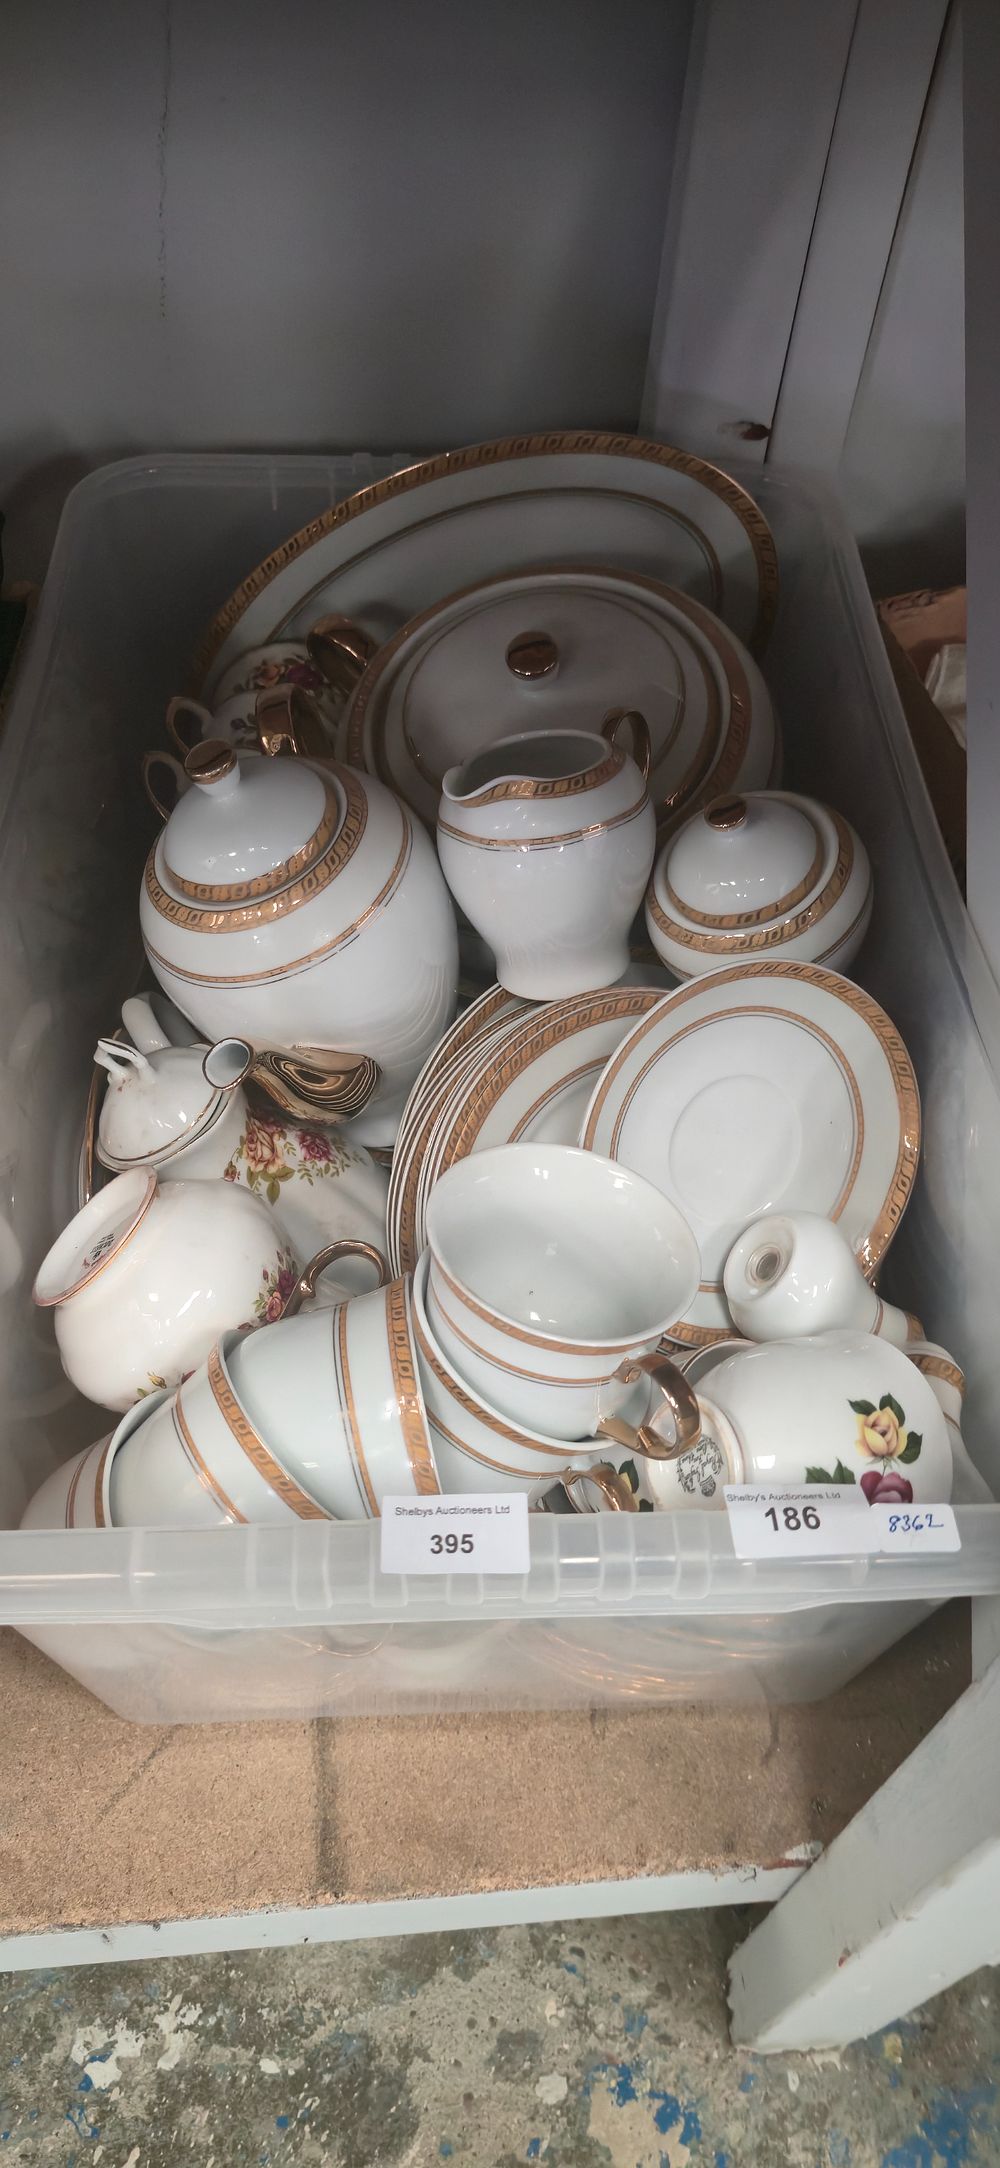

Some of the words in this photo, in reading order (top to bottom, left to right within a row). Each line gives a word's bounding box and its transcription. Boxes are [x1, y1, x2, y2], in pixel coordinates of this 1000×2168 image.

[726, 1493, 766, 1503] Shelby's
[768, 1492, 823, 1501] Auctioneers
[826, 1492, 841, 1500] Ltd
[395, 1506, 434, 1517] Shelbys
[435, 1505, 492, 1515] Auctioneers
[495, 1505, 510, 1514] Ltd
[765, 1506, 821, 1531] 186
[889, 1513, 944, 1533] 8362
[430, 1533, 474, 1555] 395
